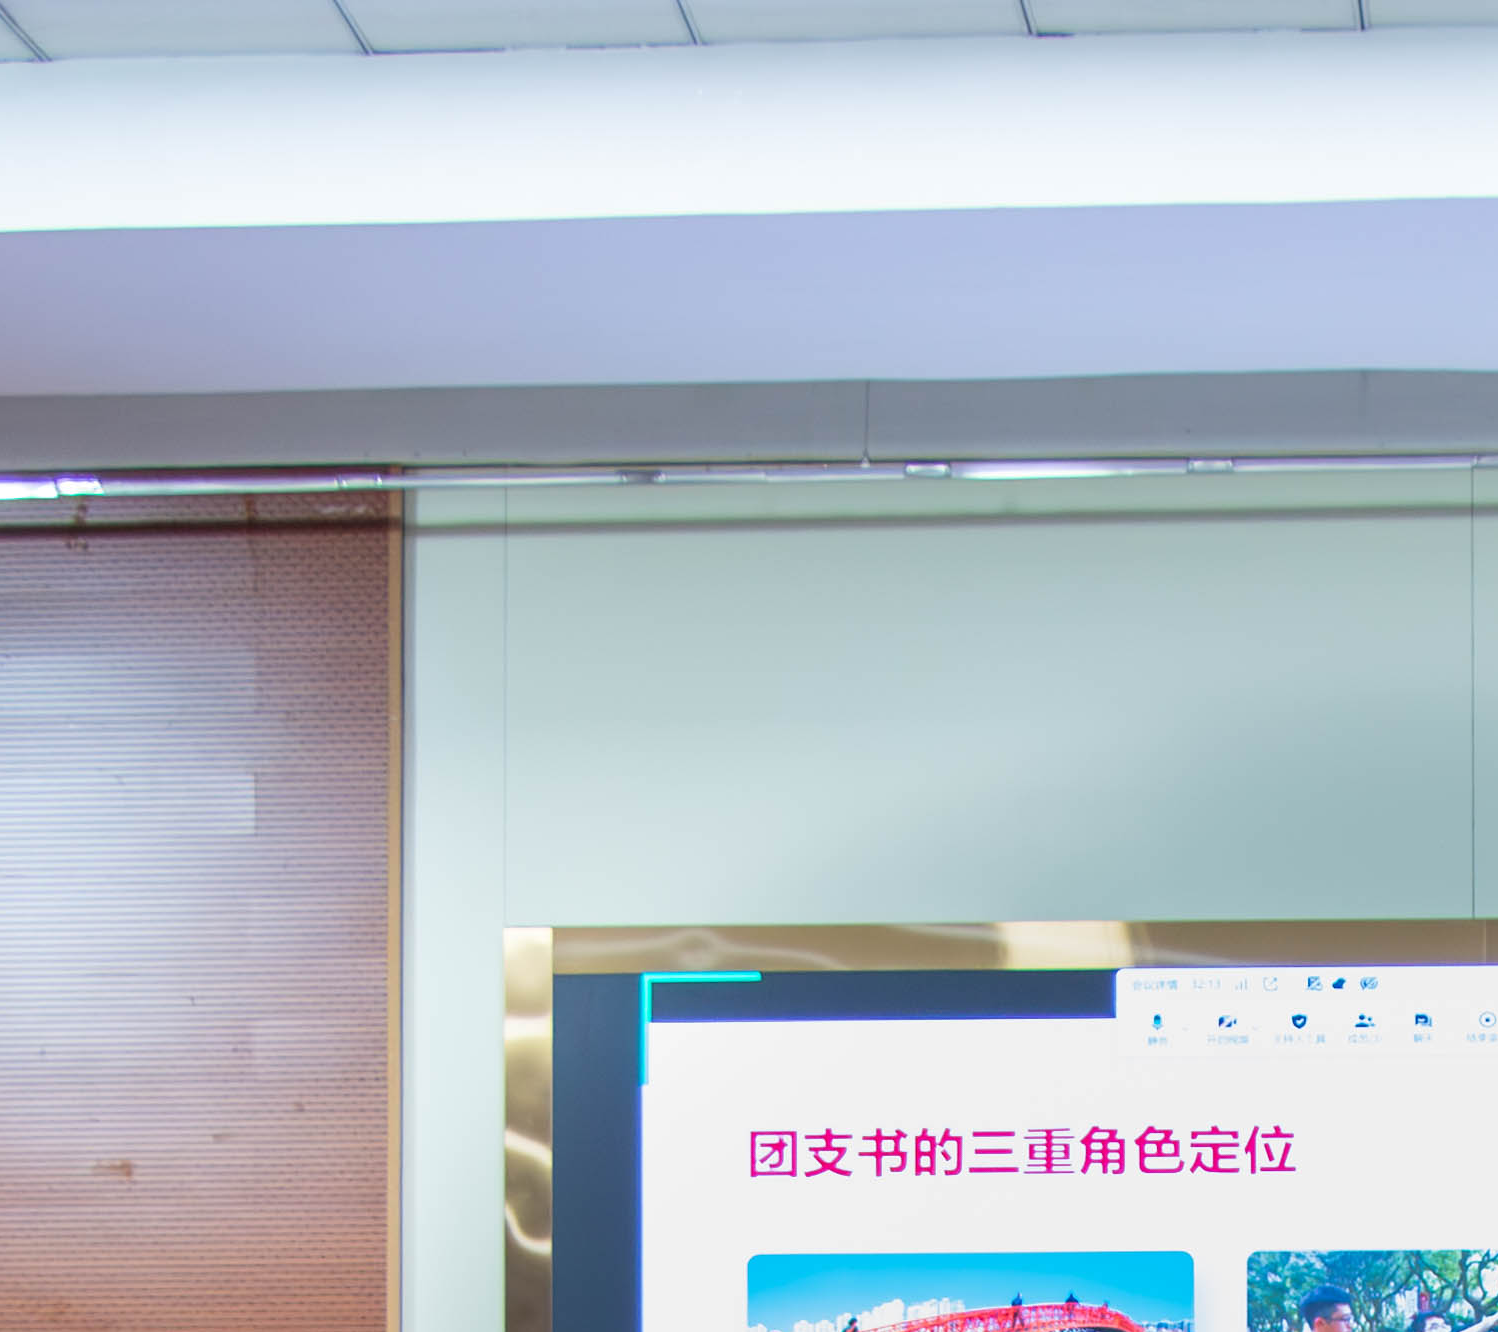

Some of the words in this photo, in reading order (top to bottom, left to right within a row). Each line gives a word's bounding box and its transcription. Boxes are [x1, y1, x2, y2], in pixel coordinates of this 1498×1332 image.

[750, 1125, 1296, 1177] 团支书的三重角色定位
